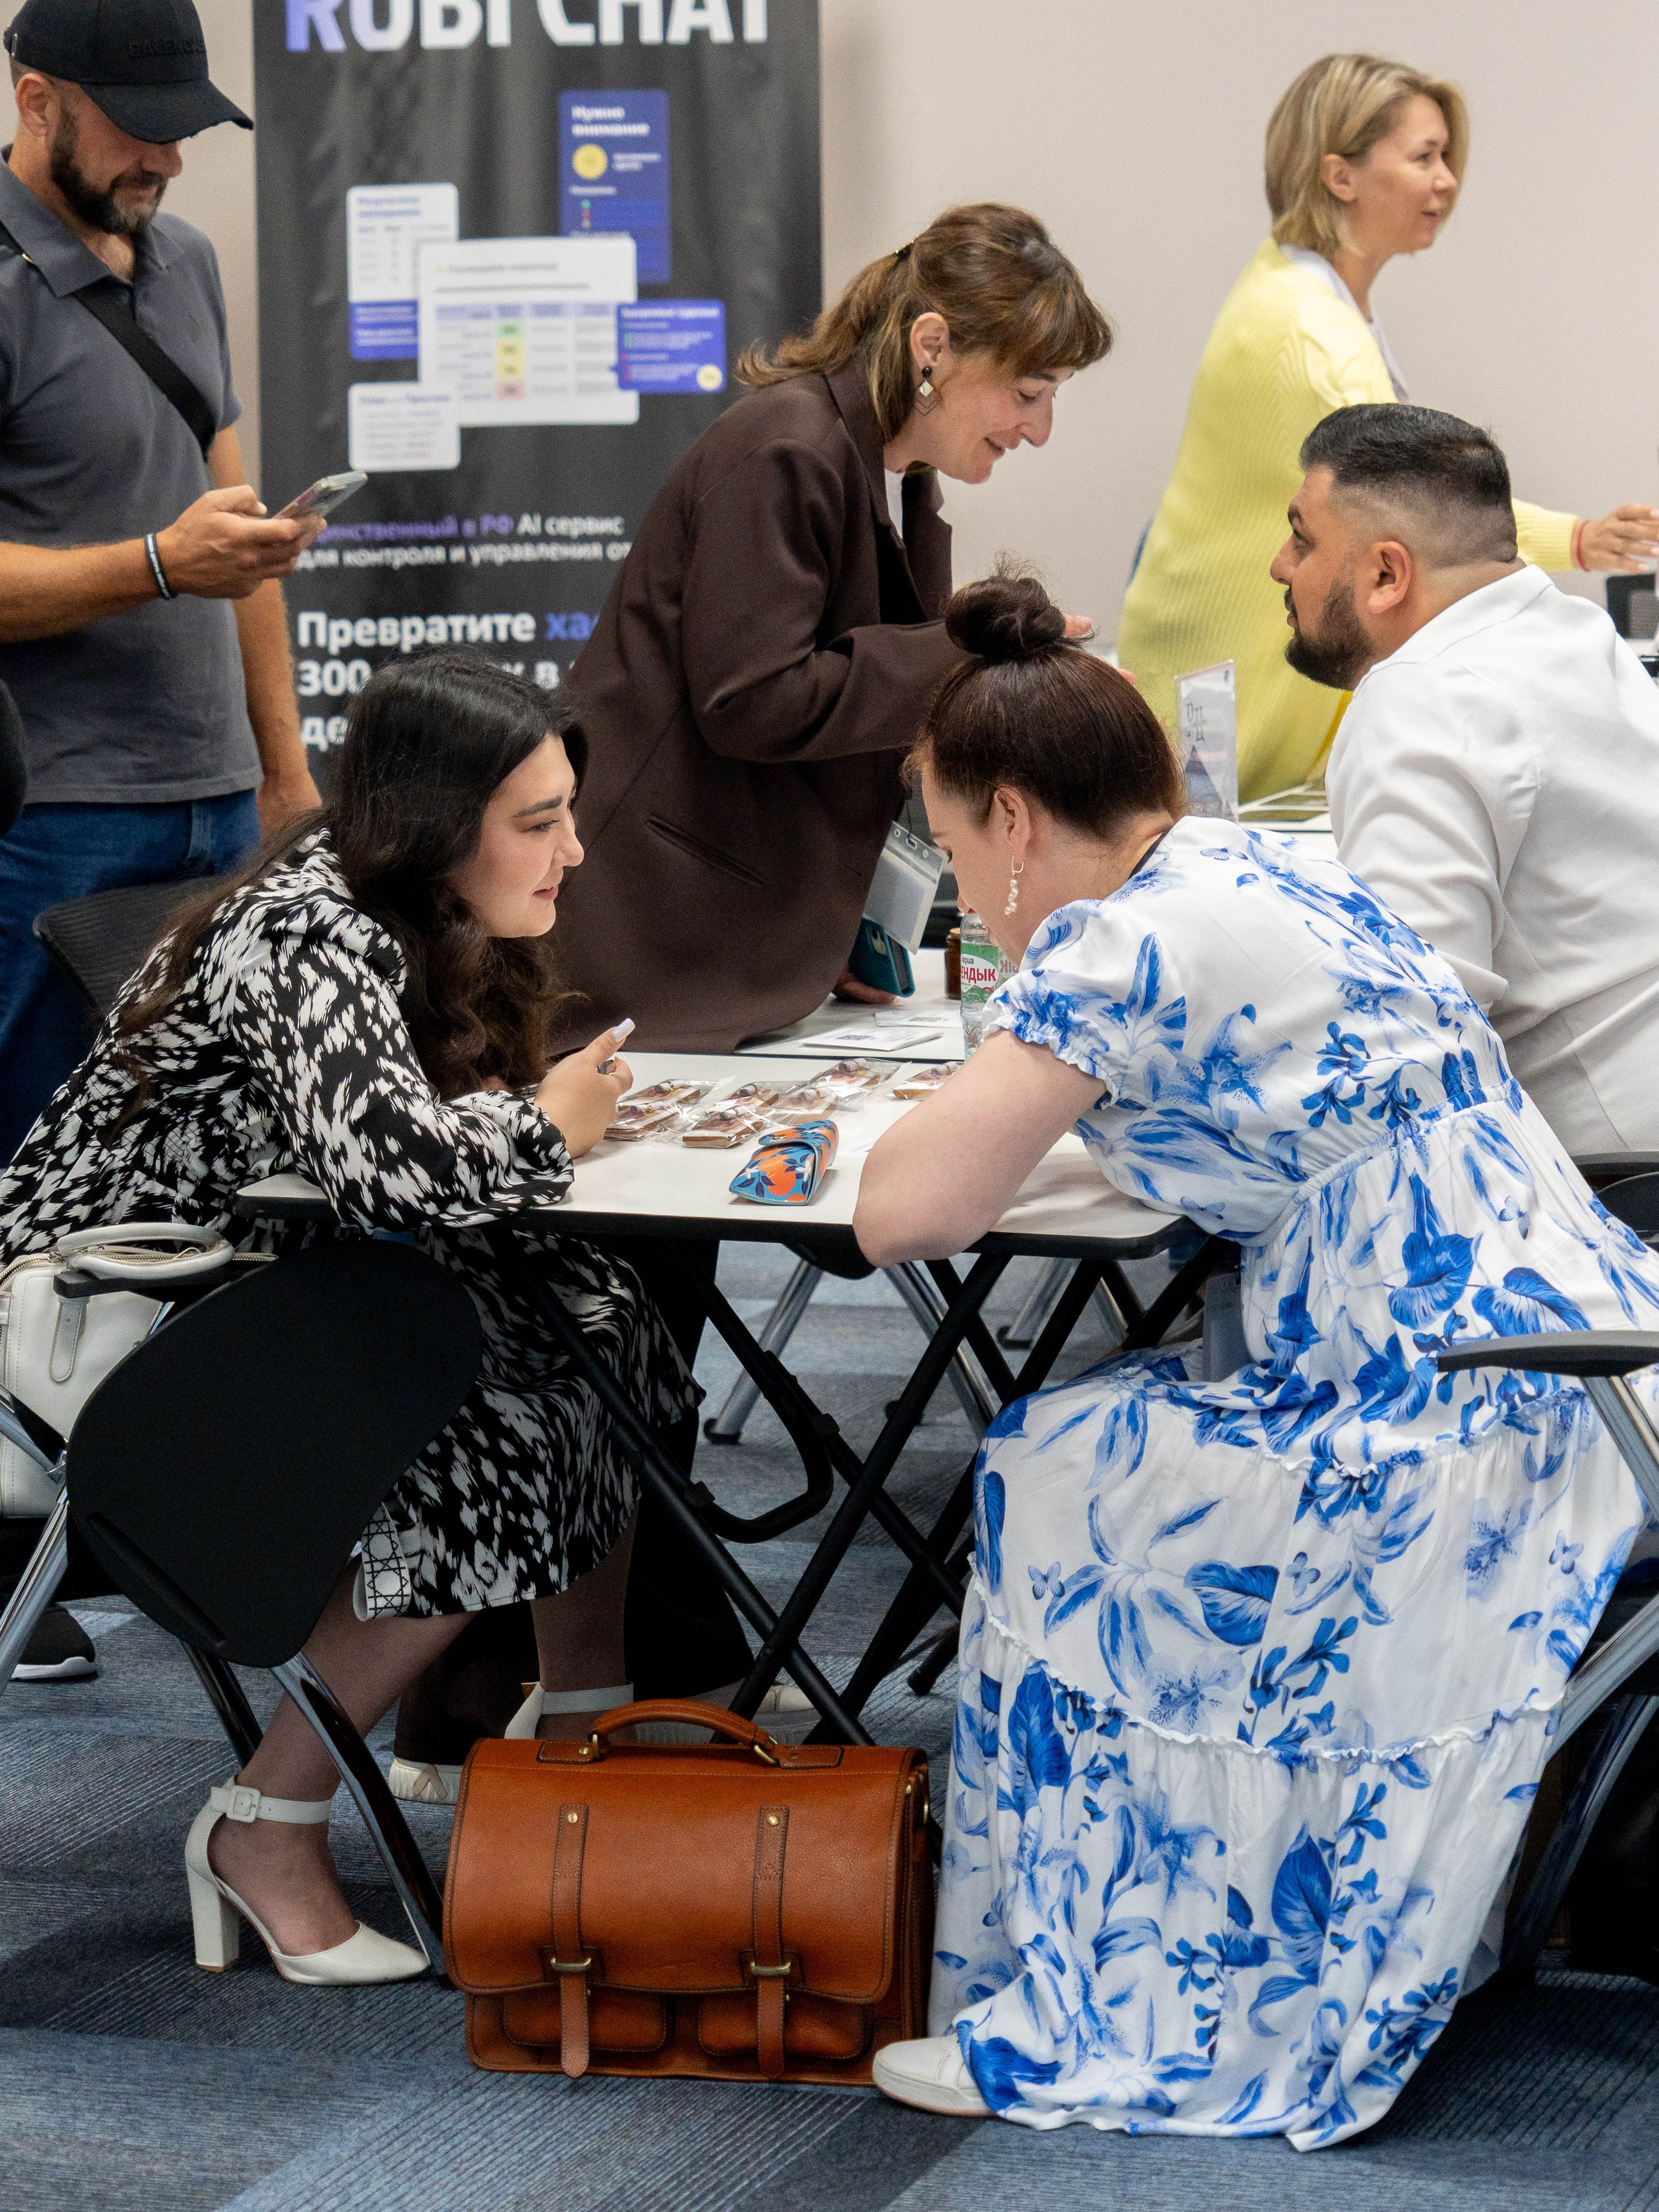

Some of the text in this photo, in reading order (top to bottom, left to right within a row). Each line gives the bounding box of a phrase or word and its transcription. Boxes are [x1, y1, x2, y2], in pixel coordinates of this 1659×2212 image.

[480, 514, 515, 537] РФ
[545, 516, 624, 539] сервис
[342, 546, 446, 570] контроля
[449, 546, 466, 564] и
[469, 542, 603, 567] управления
[298, 611, 599, 656] Превратите ха
[962, 957, 974, 965] aqua
